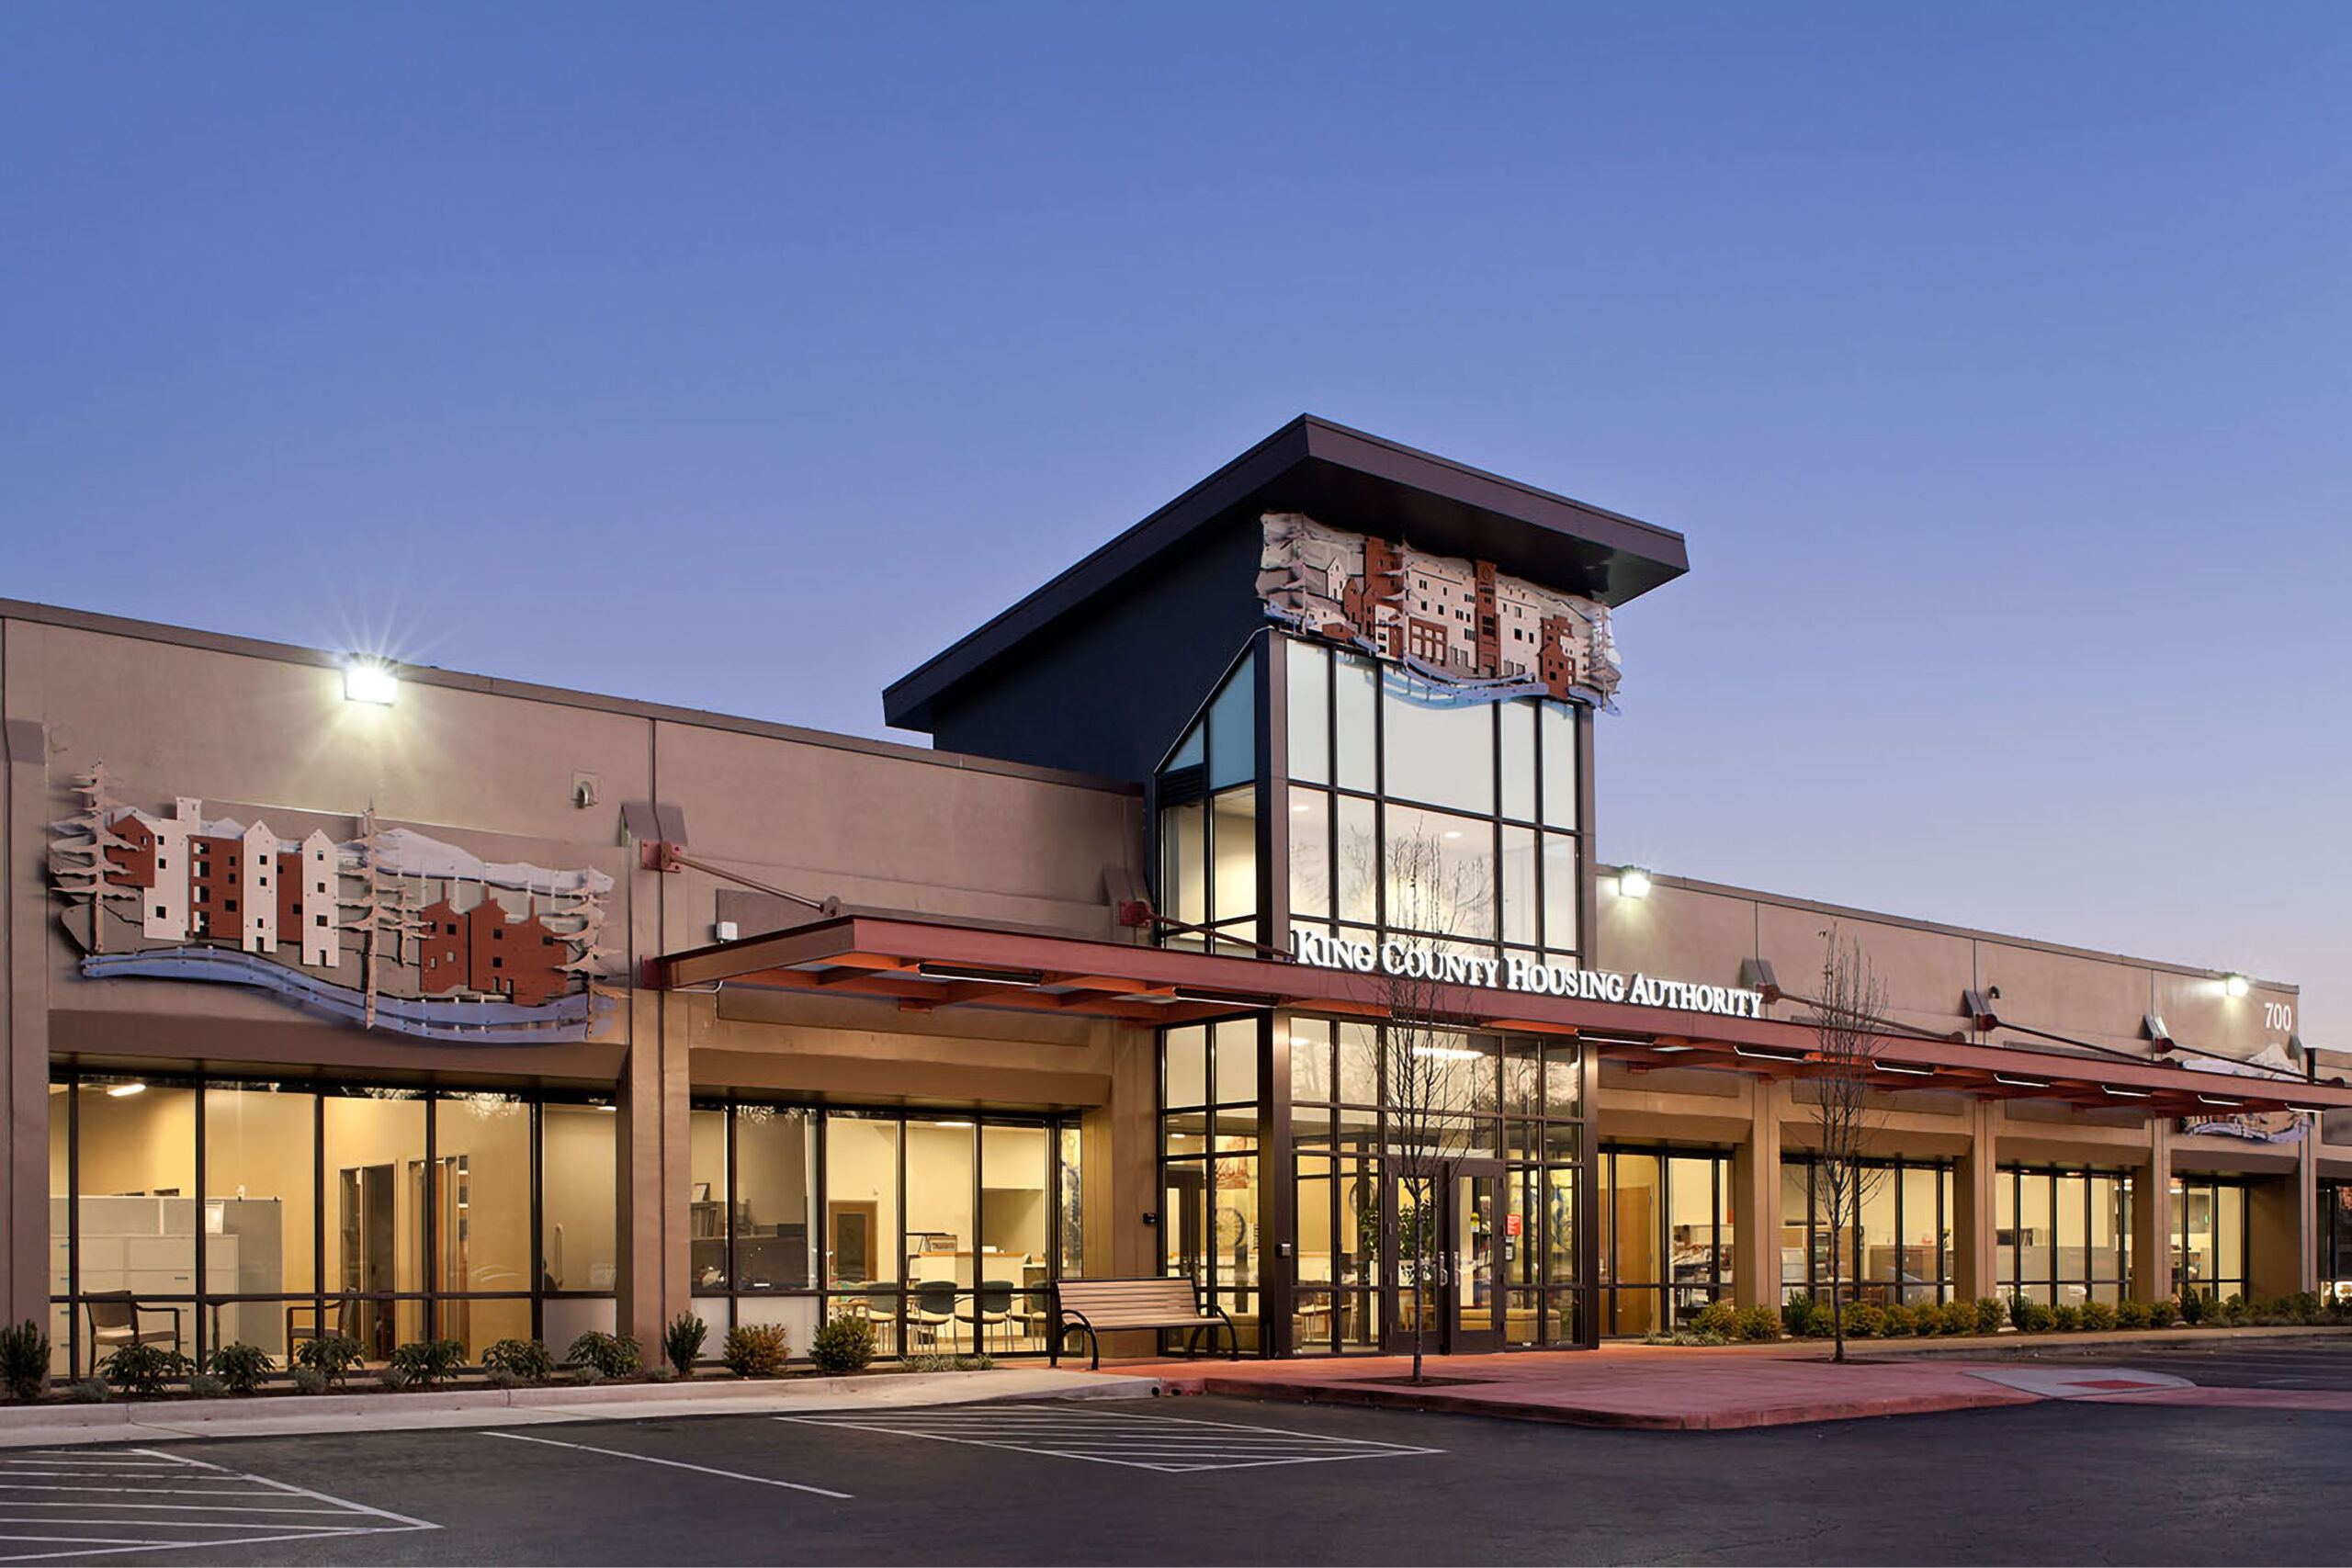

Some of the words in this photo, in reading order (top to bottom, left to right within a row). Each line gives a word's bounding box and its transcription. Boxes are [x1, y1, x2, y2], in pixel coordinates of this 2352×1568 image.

[1295, 928, 1375, 972] KING
[1382, 941, 1499, 988] COUNTY
[1507, 957, 1625, 1002] HOUSING
[1629, 973, 1763, 1019] AUTHORITY
[2264, 1002, 2292, 1032] 700
